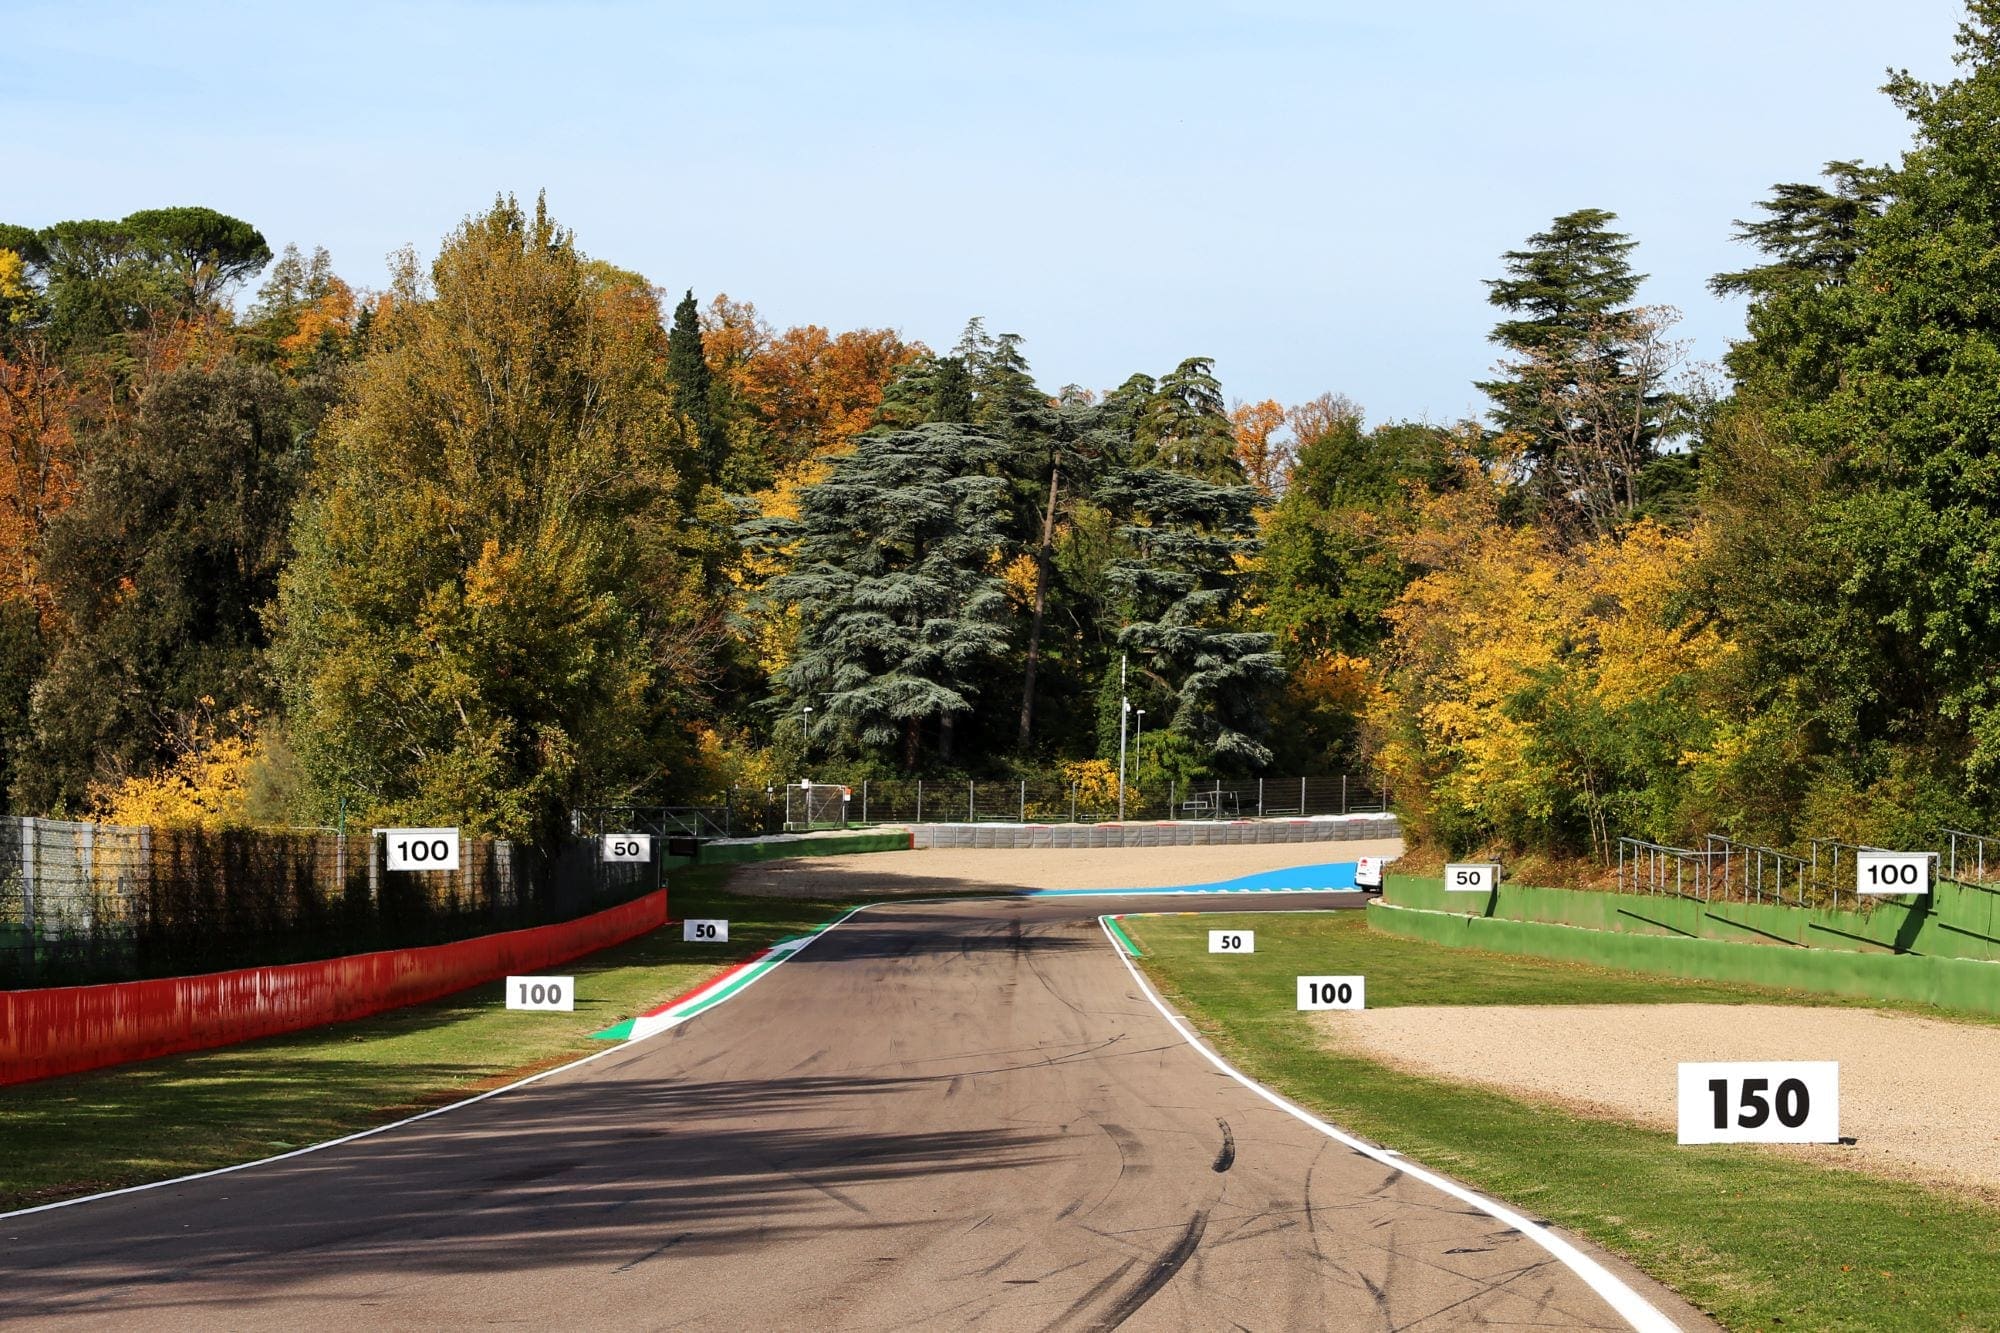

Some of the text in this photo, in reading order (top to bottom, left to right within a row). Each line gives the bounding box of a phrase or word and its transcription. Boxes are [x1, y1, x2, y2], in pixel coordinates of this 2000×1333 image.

[397, 839, 449, 862] 100
[613, 841, 640, 857] 50
[1456, 871, 1481, 886] 50
[1867, 864, 1918, 885] 100
[695, 923, 717, 940] 50
[1221, 935, 1242, 950] 50
[518, 983, 562, 1004] 100
[1308, 983, 1353, 1004] 100
[1708, 1077, 1810, 1130] 150
